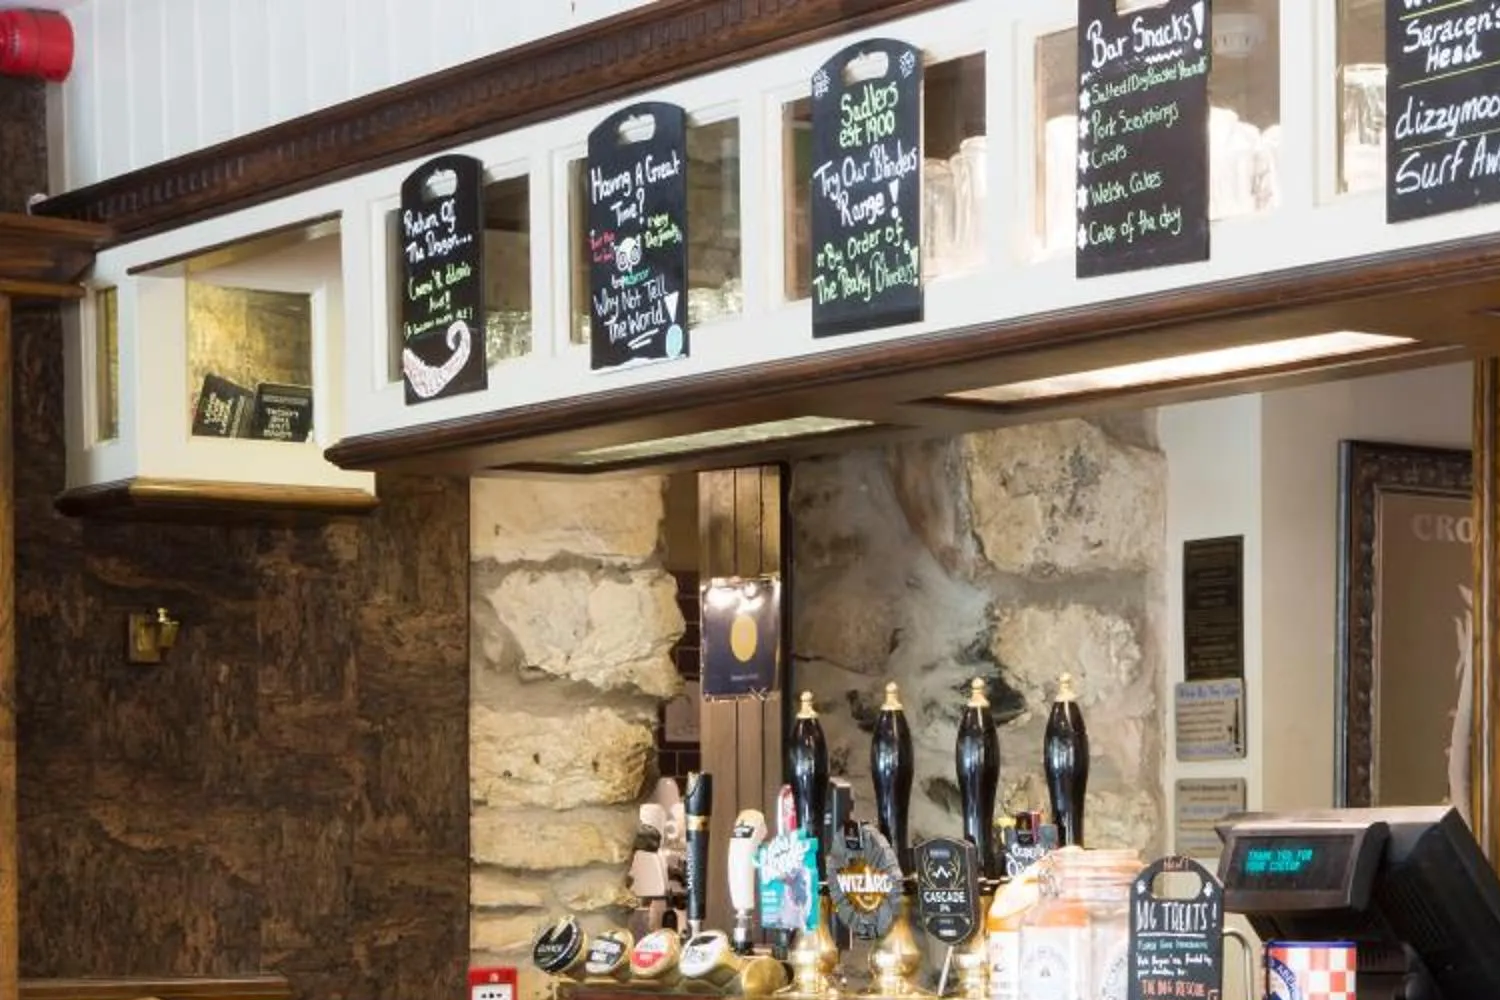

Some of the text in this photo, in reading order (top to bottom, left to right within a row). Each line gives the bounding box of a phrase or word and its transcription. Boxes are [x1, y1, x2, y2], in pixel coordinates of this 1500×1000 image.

[1086, 19, 1129, 69] Bar
[1425, 35, 1482, 73] Head
[840, 80, 899, 127] Sadlers
[839, 112, 895, 148] est 1900
[1091, 108, 1117, 144] Pork
[635, 161, 644, 187] A
[645, 150, 681, 182] Great
[813, 160, 841, 202] Try
[842, 155, 870, 188] Our
[1129, 171, 1163, 197] Cakes
[1395, 139, 1469, 195] Surf
[847, 227, 880, 259] Order
[885, 217, 904, 247] of
[1089, 202, 1182, 246] Cake of the day
[643, 272, 671, 302] Tell
[813, 274, 837, 305] The
[923, 890, 966, 904] CASCADE
[1135, 900, 1157, 932] DOG
